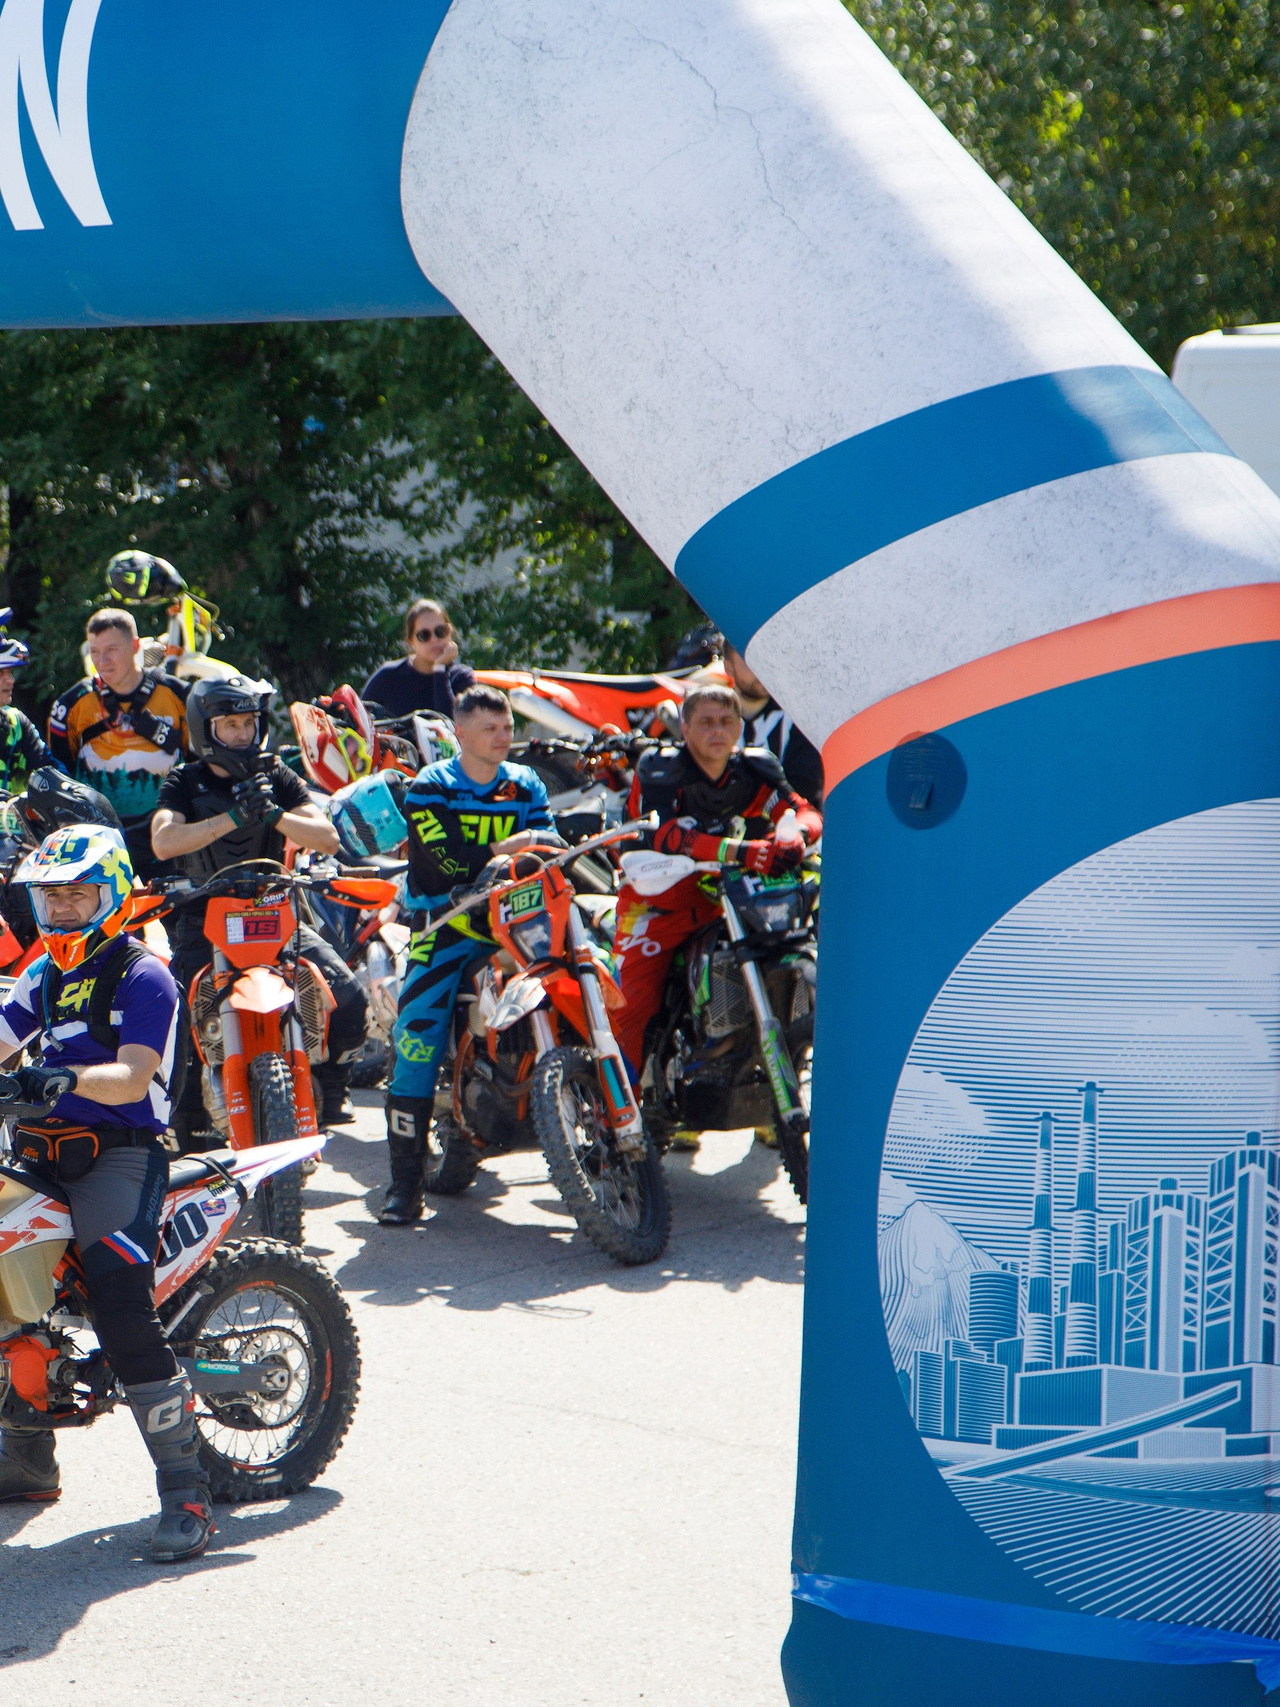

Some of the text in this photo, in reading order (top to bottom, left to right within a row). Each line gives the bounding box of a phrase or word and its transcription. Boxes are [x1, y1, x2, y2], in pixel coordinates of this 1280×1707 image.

[245, 920, 278, 935] 15
[391, 1108, 416, 1139] G
[207, 1363, 240, 1373] MOTOREX
[147, 1395, 183, 1433] G
